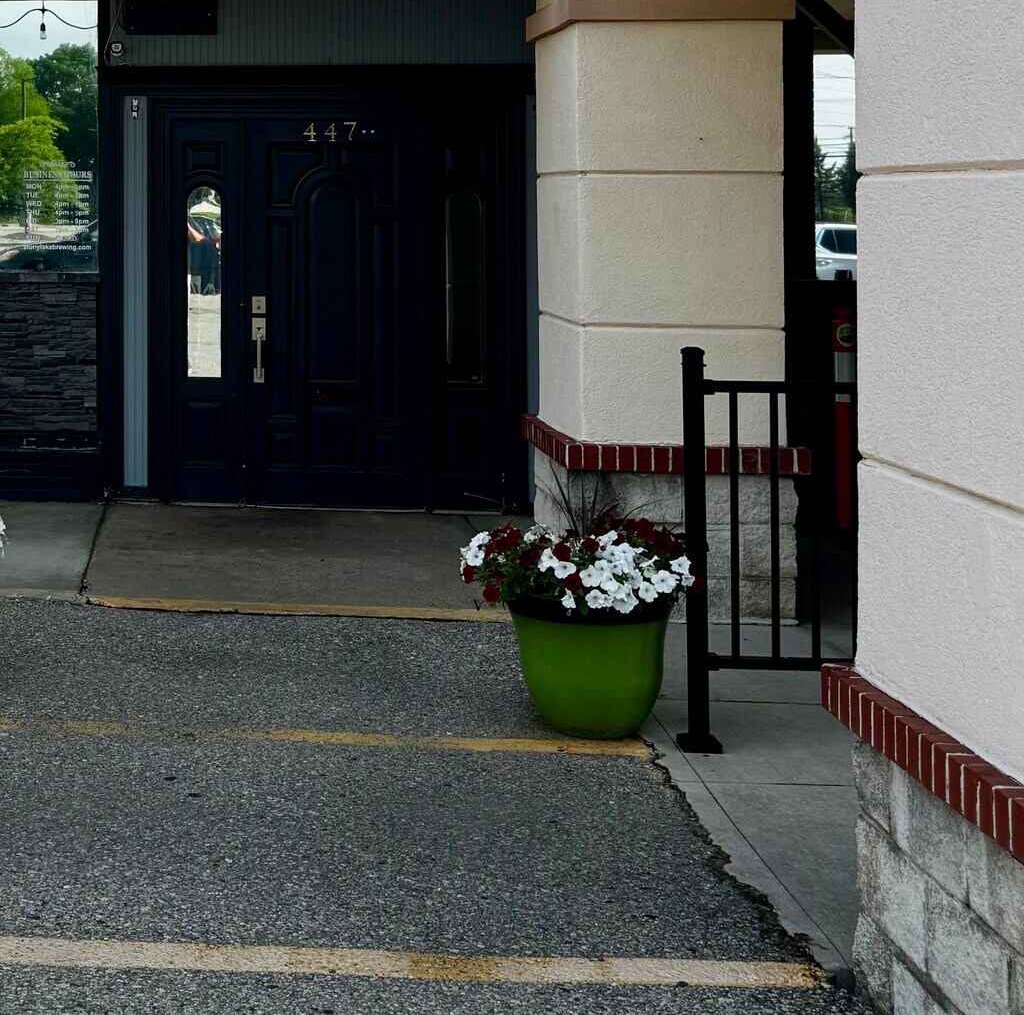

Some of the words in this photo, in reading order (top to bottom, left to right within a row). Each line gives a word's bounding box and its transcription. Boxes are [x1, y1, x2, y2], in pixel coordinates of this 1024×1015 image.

[302, 121, 357, 142] 447
[23, 170, 62, 179] BUSINESS
[63, 170, 92, 179] HOURS
[25, 191, 40, 199] TUE
[53, 192, 69, 200] 4pm
[54, 209, 69, 217] 4pm
[74, 209, 90, 217] 9pm
